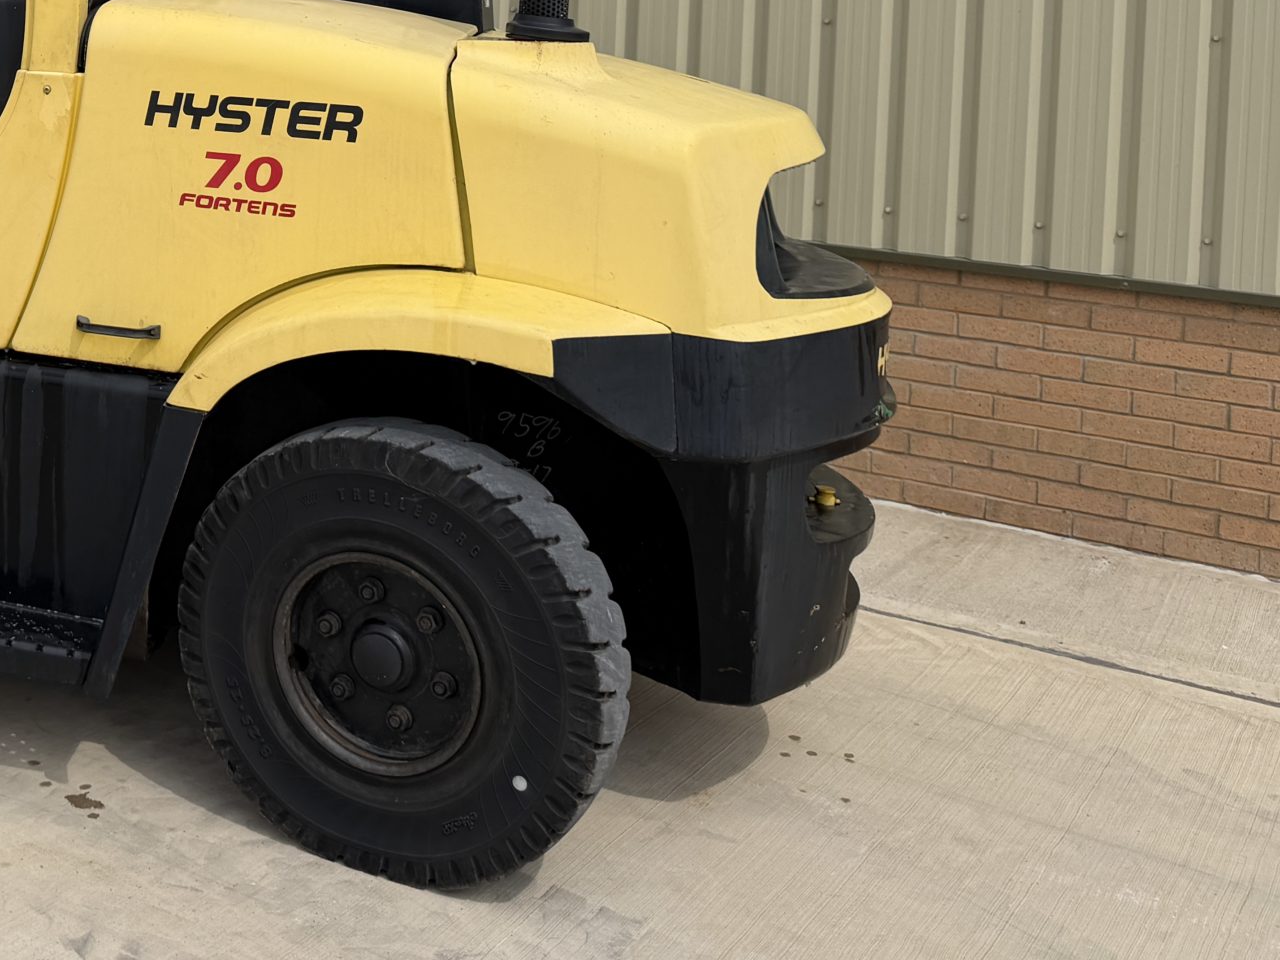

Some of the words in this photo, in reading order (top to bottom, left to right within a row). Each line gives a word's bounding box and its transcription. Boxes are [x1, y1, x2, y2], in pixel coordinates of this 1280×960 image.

[144, 90, 364, 143] HYSTER
[204, 151, 284, 193] 7.0
[178, 193, 297, 218] FORTENS
[497, 410, 562, 440] 9596
[335, 486, 482, 559] TRELLEBORG
